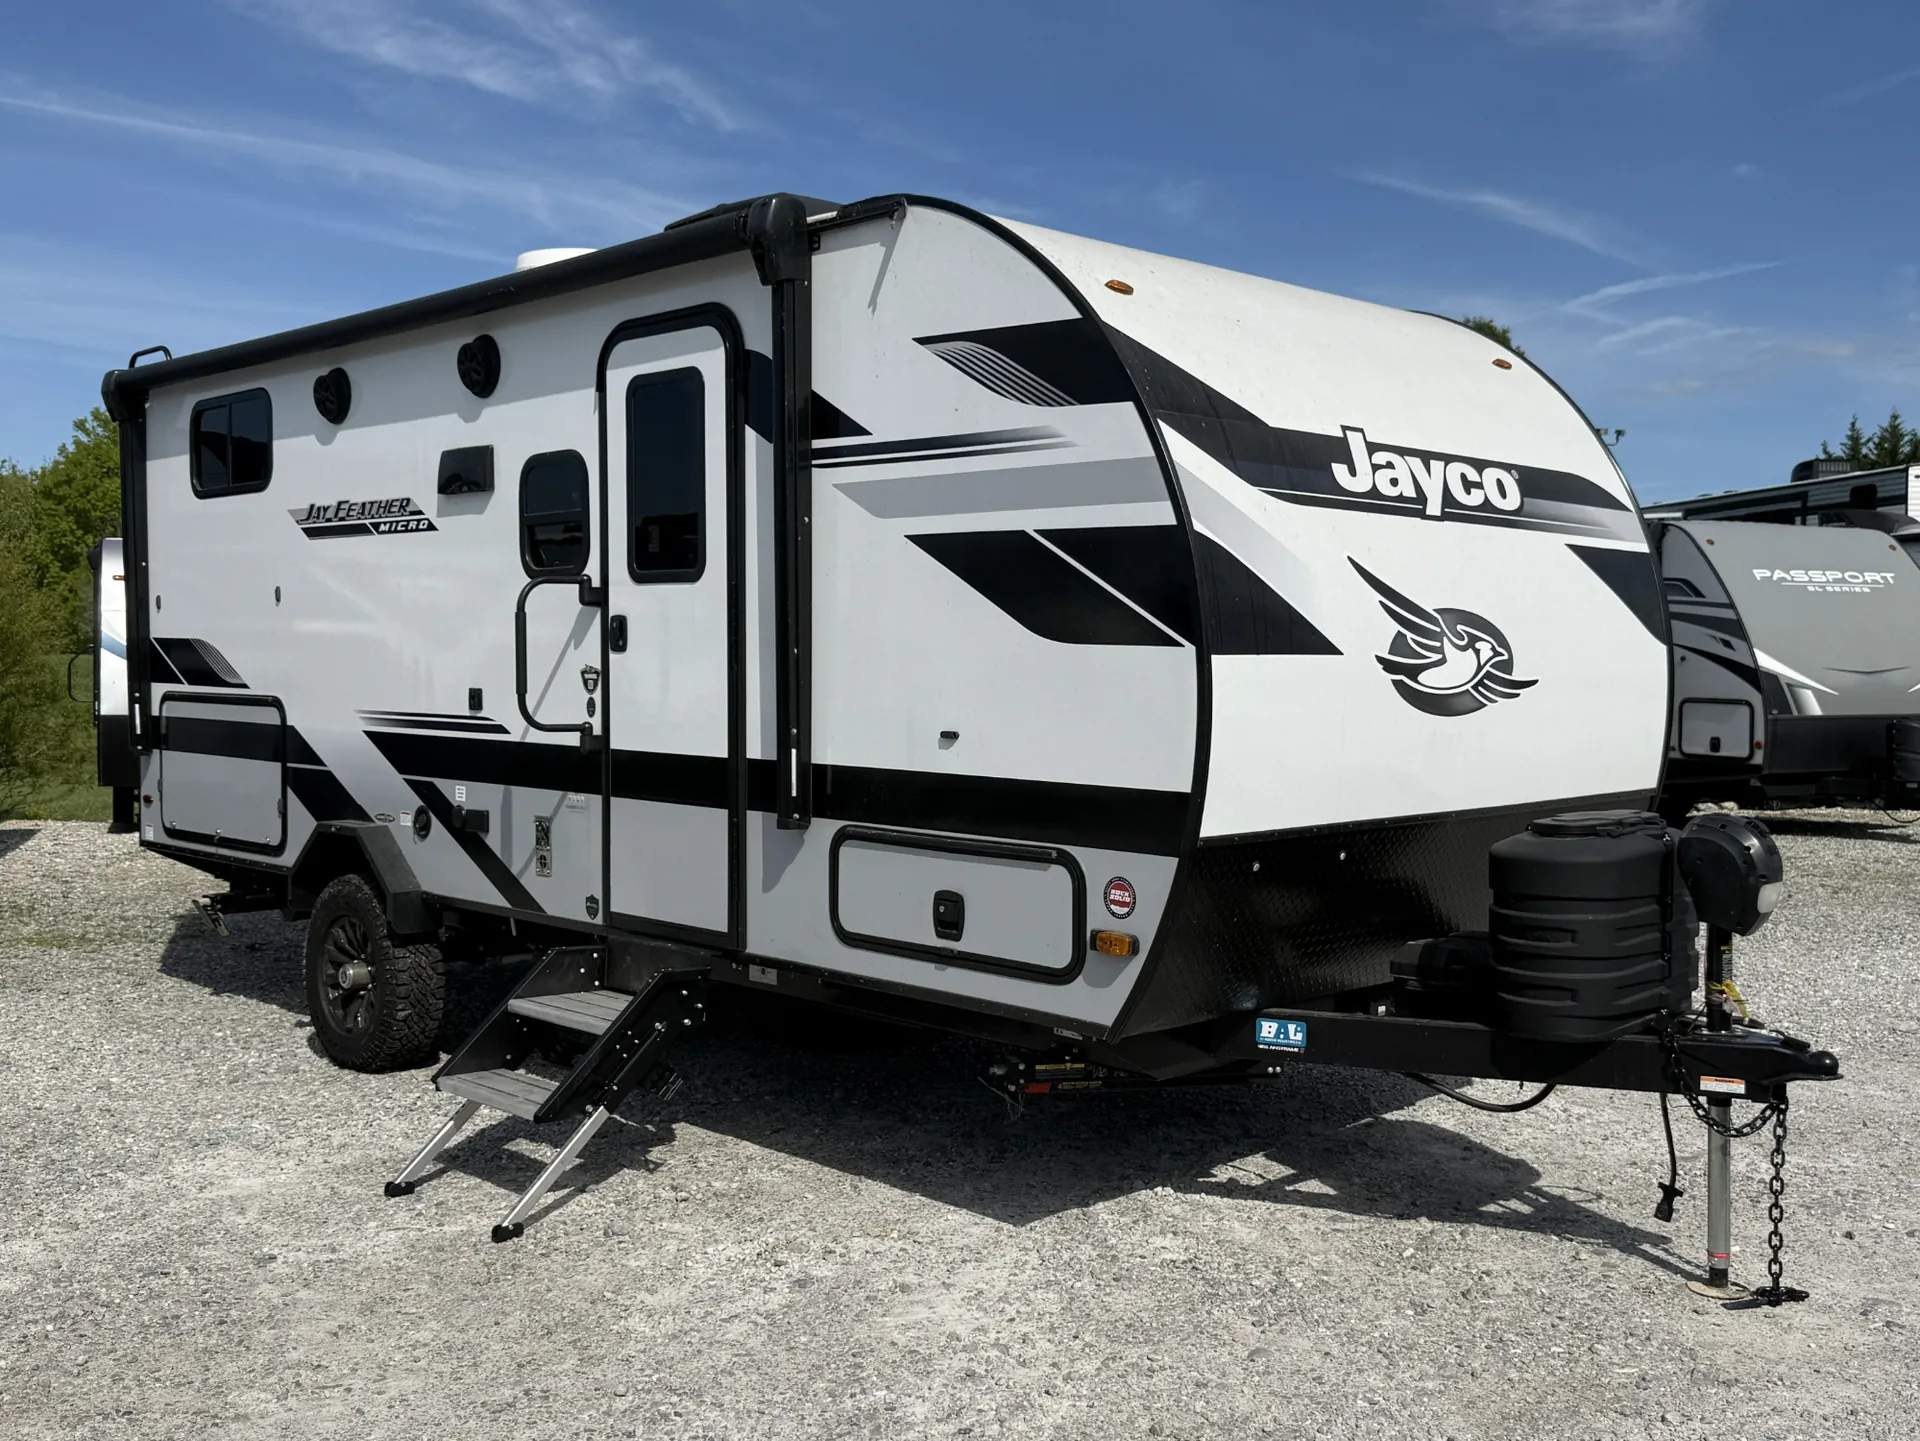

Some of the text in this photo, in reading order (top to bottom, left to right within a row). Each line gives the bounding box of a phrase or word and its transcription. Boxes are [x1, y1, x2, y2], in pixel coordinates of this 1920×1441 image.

[1331, 430, 1521, 516] Jayco
[298, 497, 411, 524] JAY FEATHER
[378, 519, 429, 532] MICRO
[1752, 569, 1895, 584] PASSPORT
[1109, 894, 1131, 903] SOLID
[1110, 889, 1130, 898] ROCK
